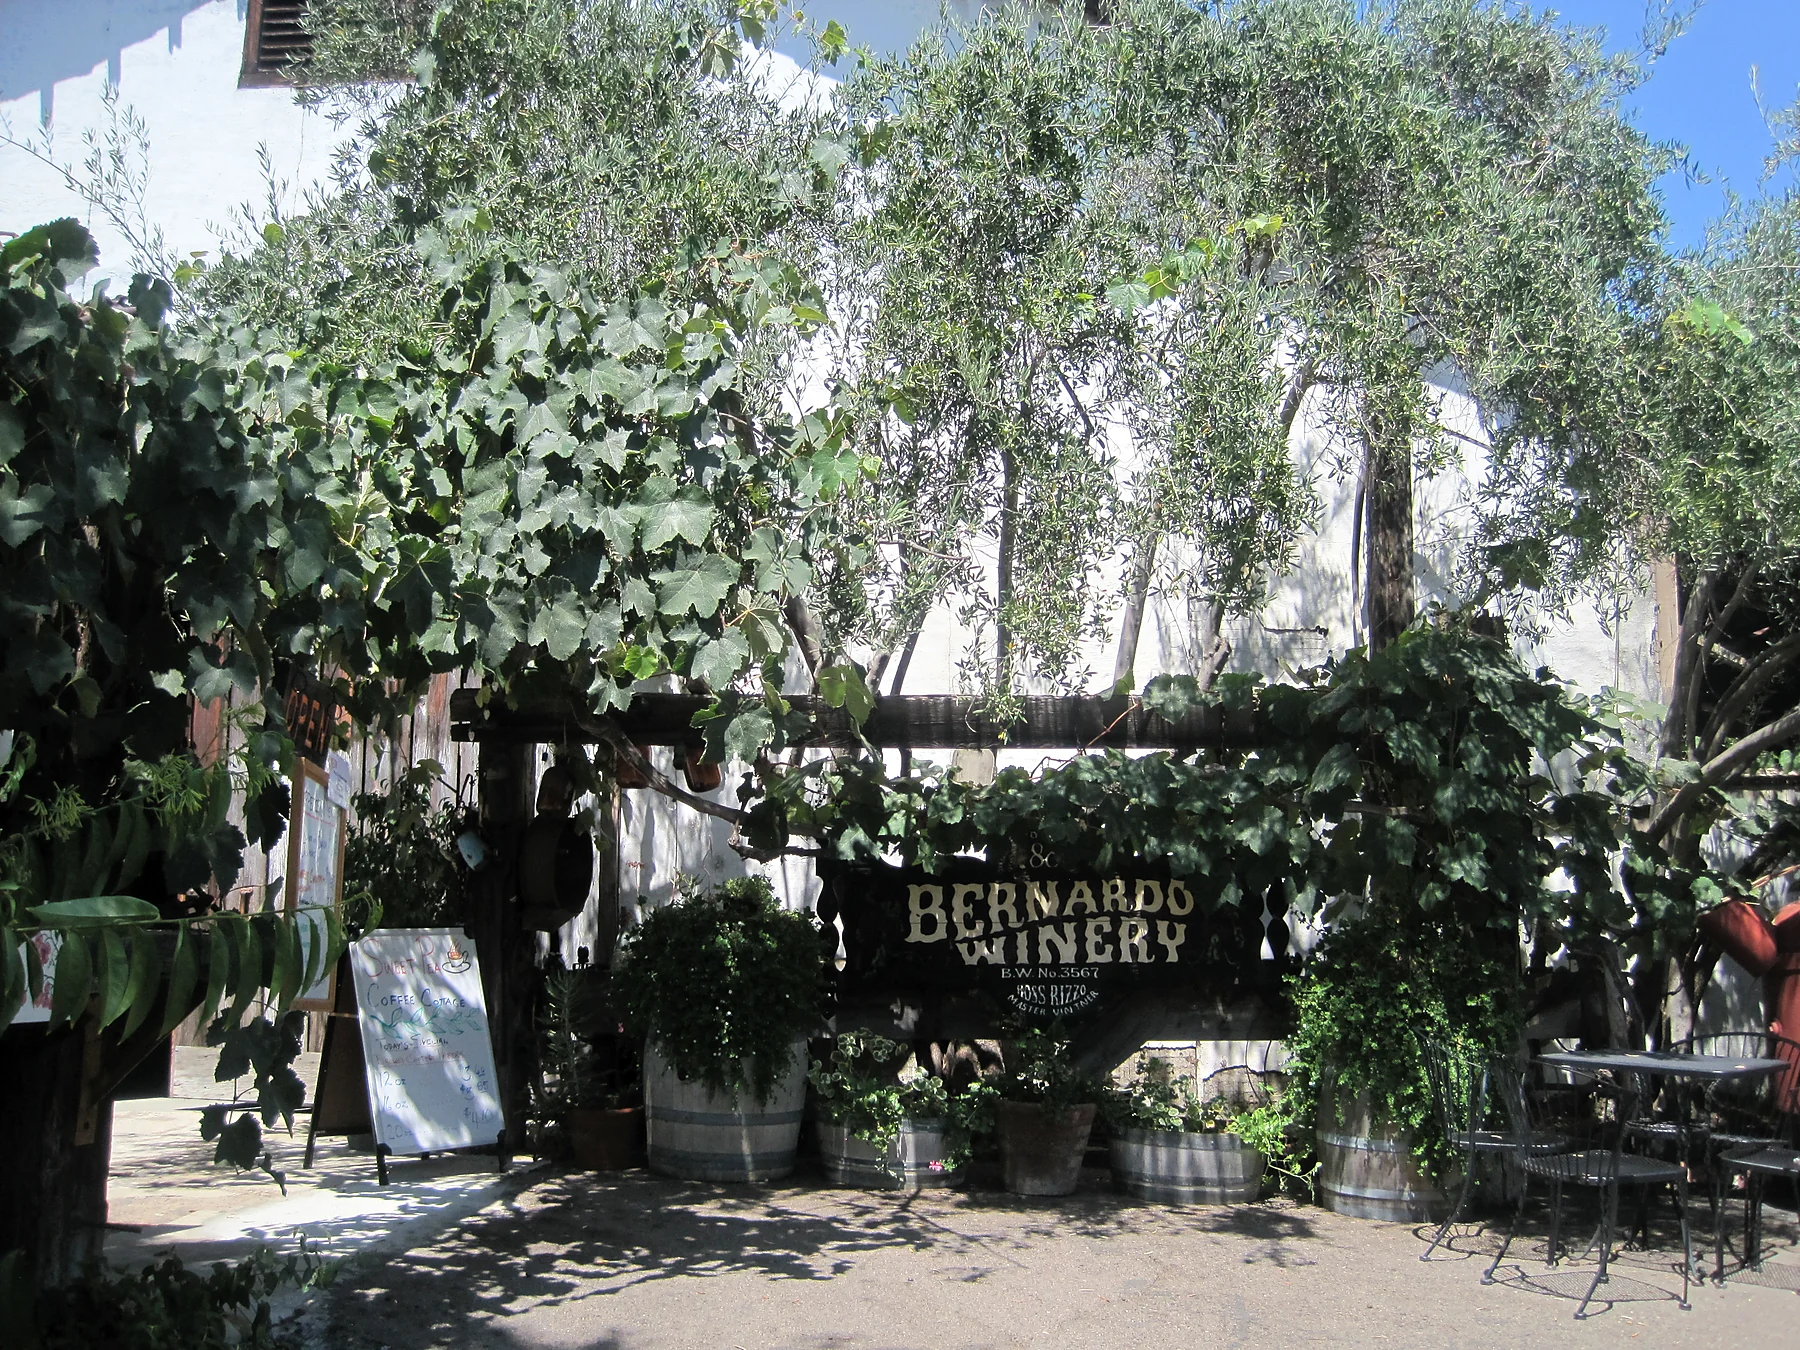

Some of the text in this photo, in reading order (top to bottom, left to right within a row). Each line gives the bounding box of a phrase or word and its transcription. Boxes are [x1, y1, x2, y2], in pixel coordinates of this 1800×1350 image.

[285, 687, 330, 755] OPEN
[904, 878, 1195, 944] BERNARDO
[955, 916, 1188, 966] WINERY
[362, 935, 442, 978] SWEET PEA
[367, 983, 466, 1008] COFFEE COTTAGE
[1007, 990, 1099, 1016] MASTER VINTNER
[1017, 984, 1087, 1006] ROSS RIZZO
[379, 1070, 392, 1088] 12
[383, 1095, 393, 1111] 16
